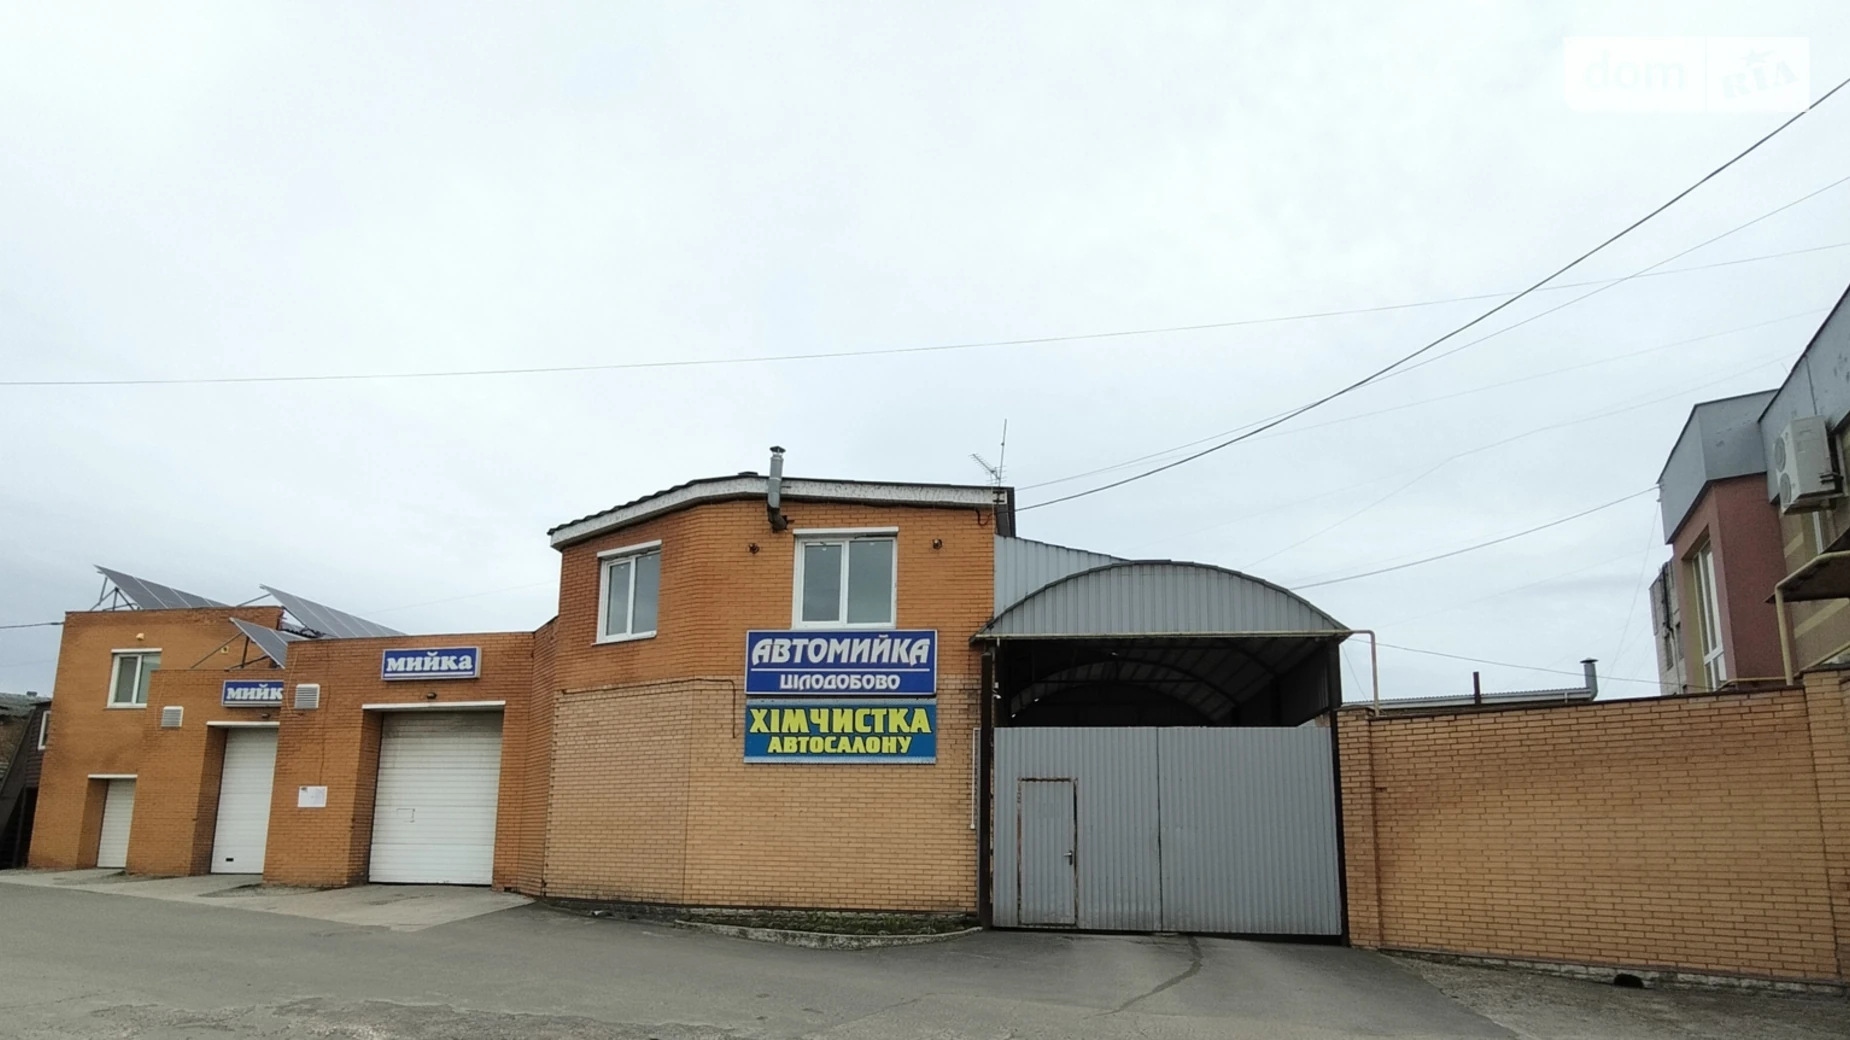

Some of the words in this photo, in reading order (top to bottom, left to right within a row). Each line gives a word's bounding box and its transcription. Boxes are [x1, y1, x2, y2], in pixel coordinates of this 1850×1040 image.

[752, 634, 930, 666] АВТОМИЙКА
[780, 674, 901, 690] ЦІЛОДОБОВО
[226, 683, 284, 700] мийк
[750, 708, 932, 733] ХІМЧИСТКА
[767, 736, 912, 754] АВТОСАЛОНУ
